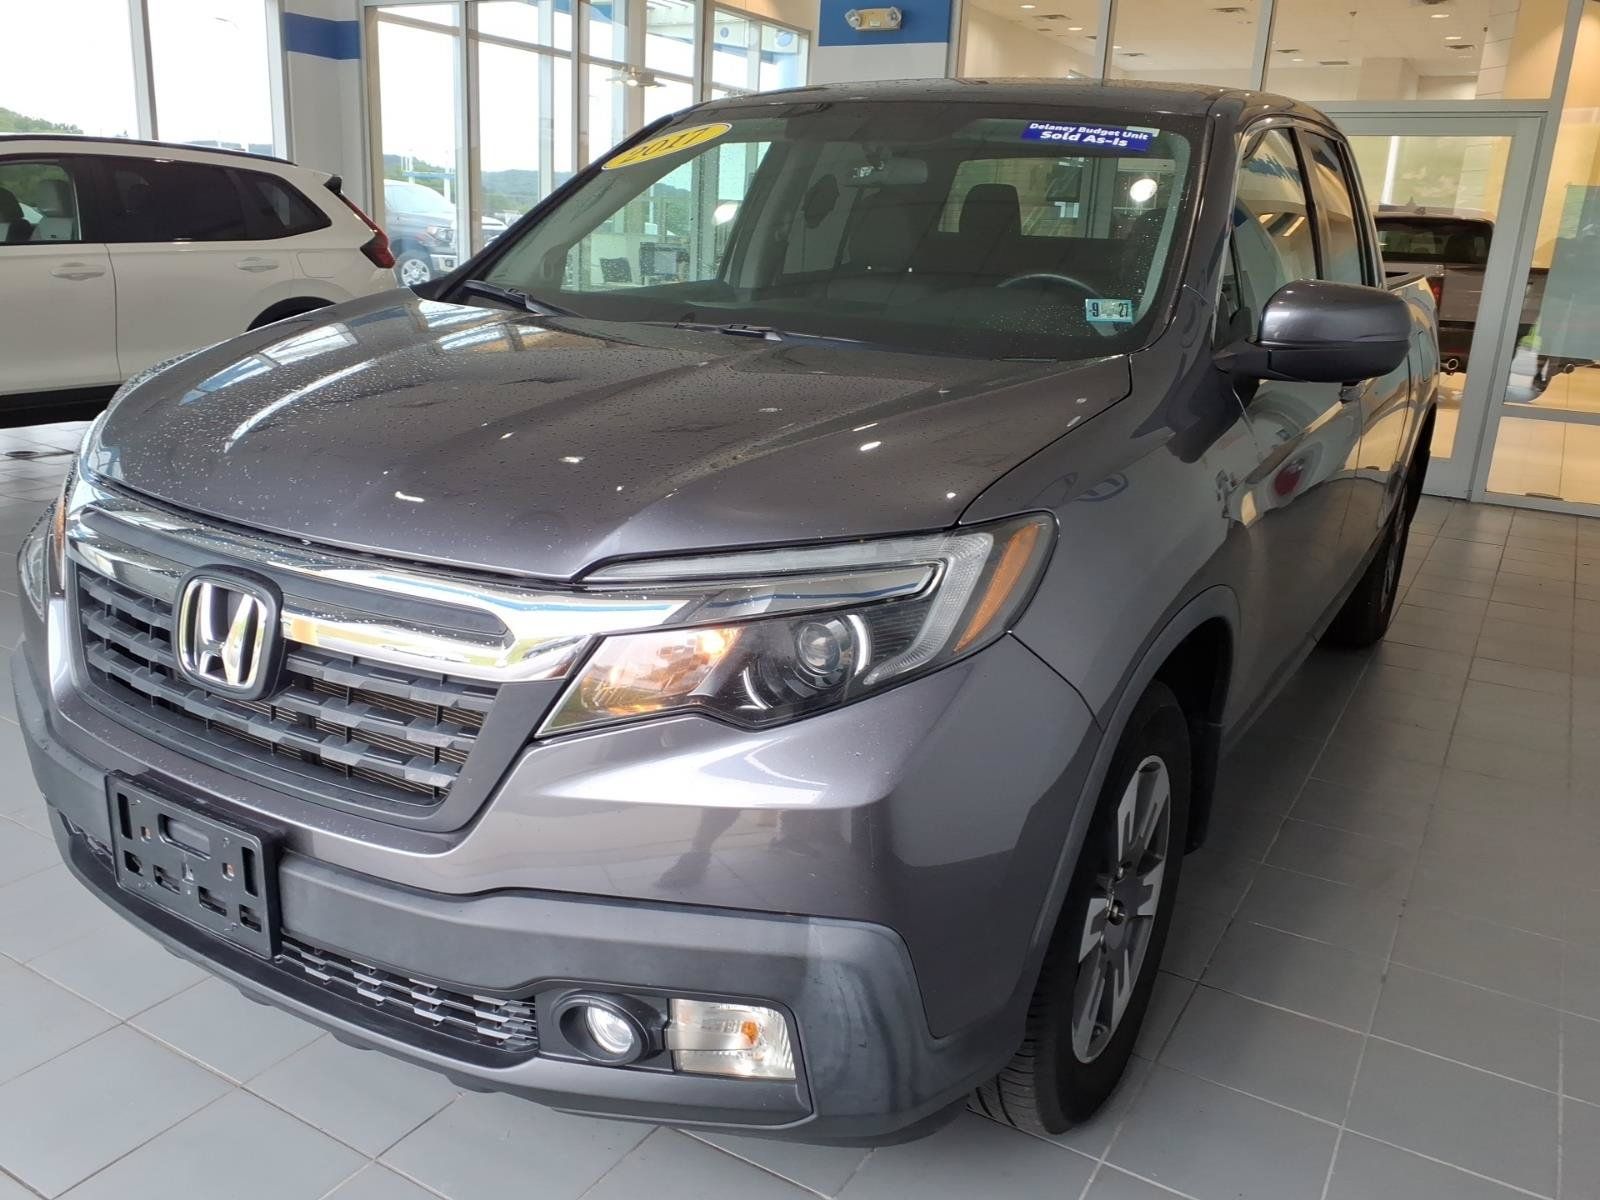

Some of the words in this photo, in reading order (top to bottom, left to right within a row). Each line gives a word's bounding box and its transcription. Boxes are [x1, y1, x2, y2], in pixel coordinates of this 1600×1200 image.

[1029, 123, 1076, 133] Delaney
[1078, 127, 1120, 137] Budget
[1122, 131, 1149, 140] Unit
[1040, 131, 1080, 141] Sold
[1082, 134, 1129, 147] As-Is
[617, 126, 713, 163] 2017
[1091, 302, 1099, 317] 9
